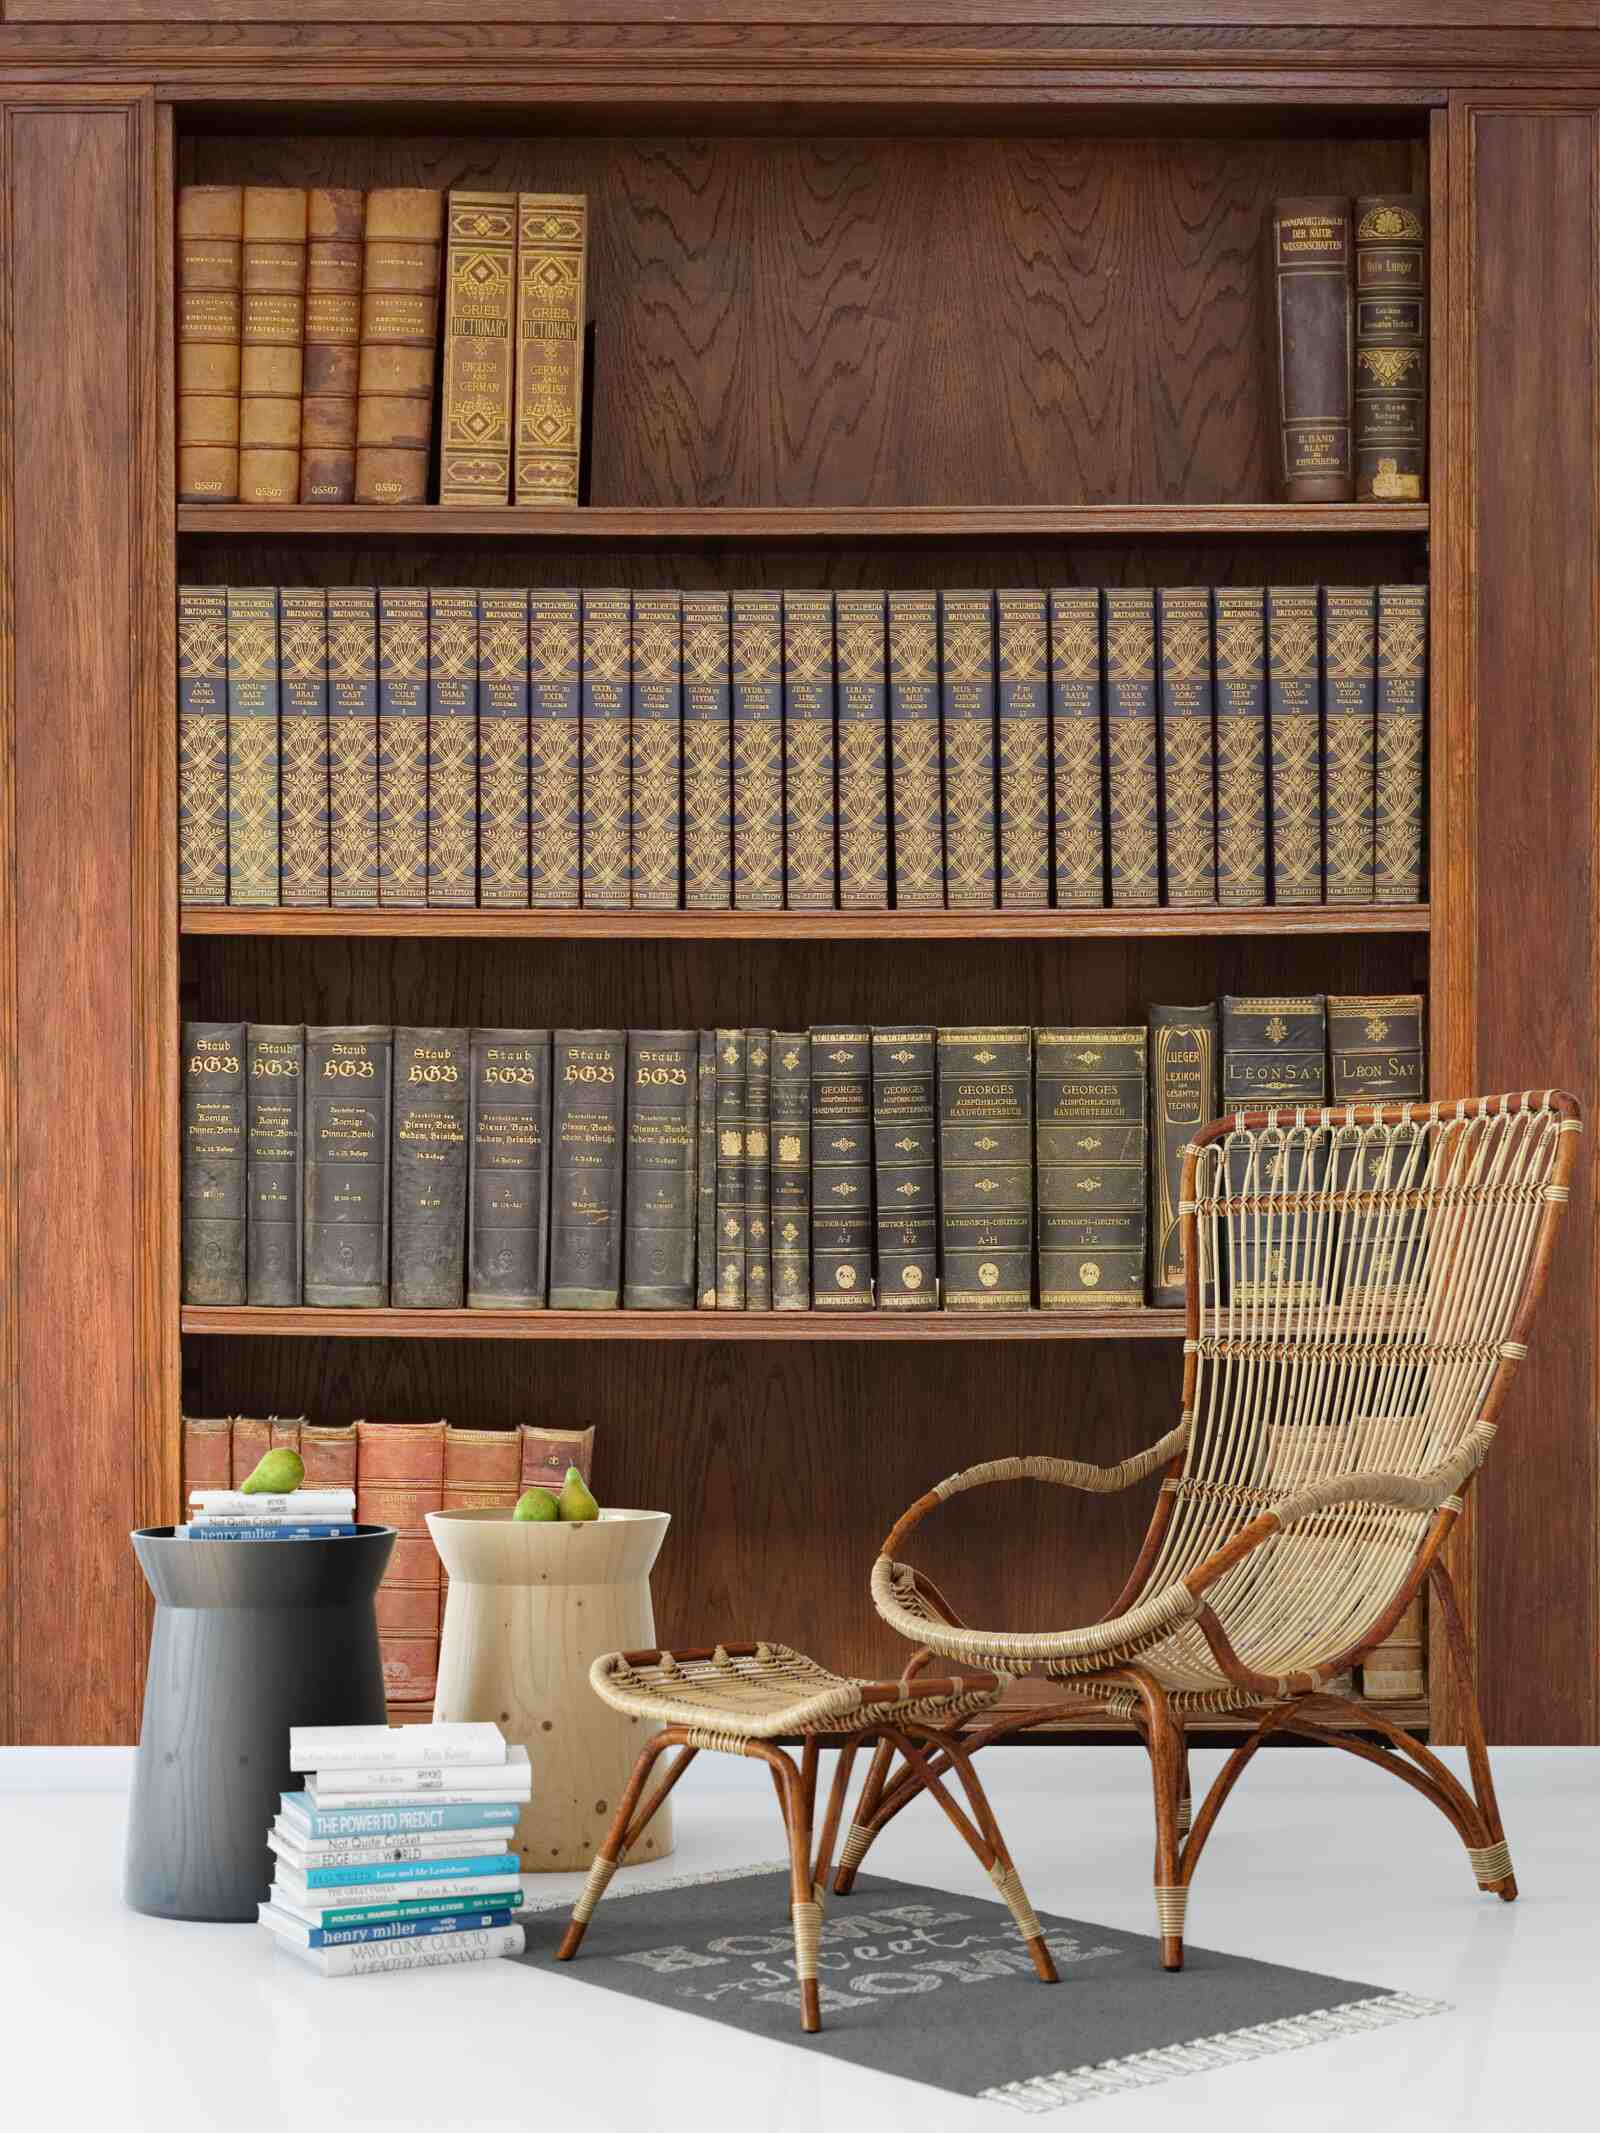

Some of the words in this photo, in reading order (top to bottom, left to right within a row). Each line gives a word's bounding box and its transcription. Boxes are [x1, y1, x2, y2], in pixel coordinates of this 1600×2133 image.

[1292, 228, 1306, 239] DER
[454, 319, 507, 337] DICTIONARY
[523, 321, 577, 340] DICTIONARY
[529, 365, 569, 377] GERMAN
[459, 383, 499, 393] GERMAN
[197, 1039, 230, 1051] Staub
[258, 1043, 297, 1055] Staub
[331, 1043, 368, 1056] Staub
[414, 1048, 452, 1060] Staub
[487, 1049, 531, 1061] Staub
[568, 1048, 611, 1061] Staub
[639, 1051, 681, 1062] Staub
[1167, 1051, 1200, 1063] LUEGER
[188, 1056, 240, 1076] HGB
[252, 1060, 300, 1080] HGB
[322, 1060, 375, 1080] HGB
[408, 1065, 458, 1085] HGB
[484, 1066, 535, 1087] HGB
[563, 1065, 615, 1086] HGB
[635, 1067, 687, 1088] HGB
[1165, 1071, 1201, 1081] LEXIKON
[958, 1085, 1015, 1095] GEORGES
[1062, 1085, 1118, 1095] GEORGES
[199, 1528, 238, 1540] henry
[240, 1528, 278, 1539] miller
[317, 1815, 339, 1834] THE
[340, 1812, 381, 1833] POWER
[381, 1811, 398, 1830] TO
[399, 1808, 445, 1828] PREDICT
[328, 1838, 349, 1850] Not
[351, 1835, 380, 1850] Quite
[321, 1852, 349, 1865] EDGE
[322, 1928, 368, 1945] henry
[373, 1921, 417, 1938] miller
[470, 1931, 489, 1946] TO
